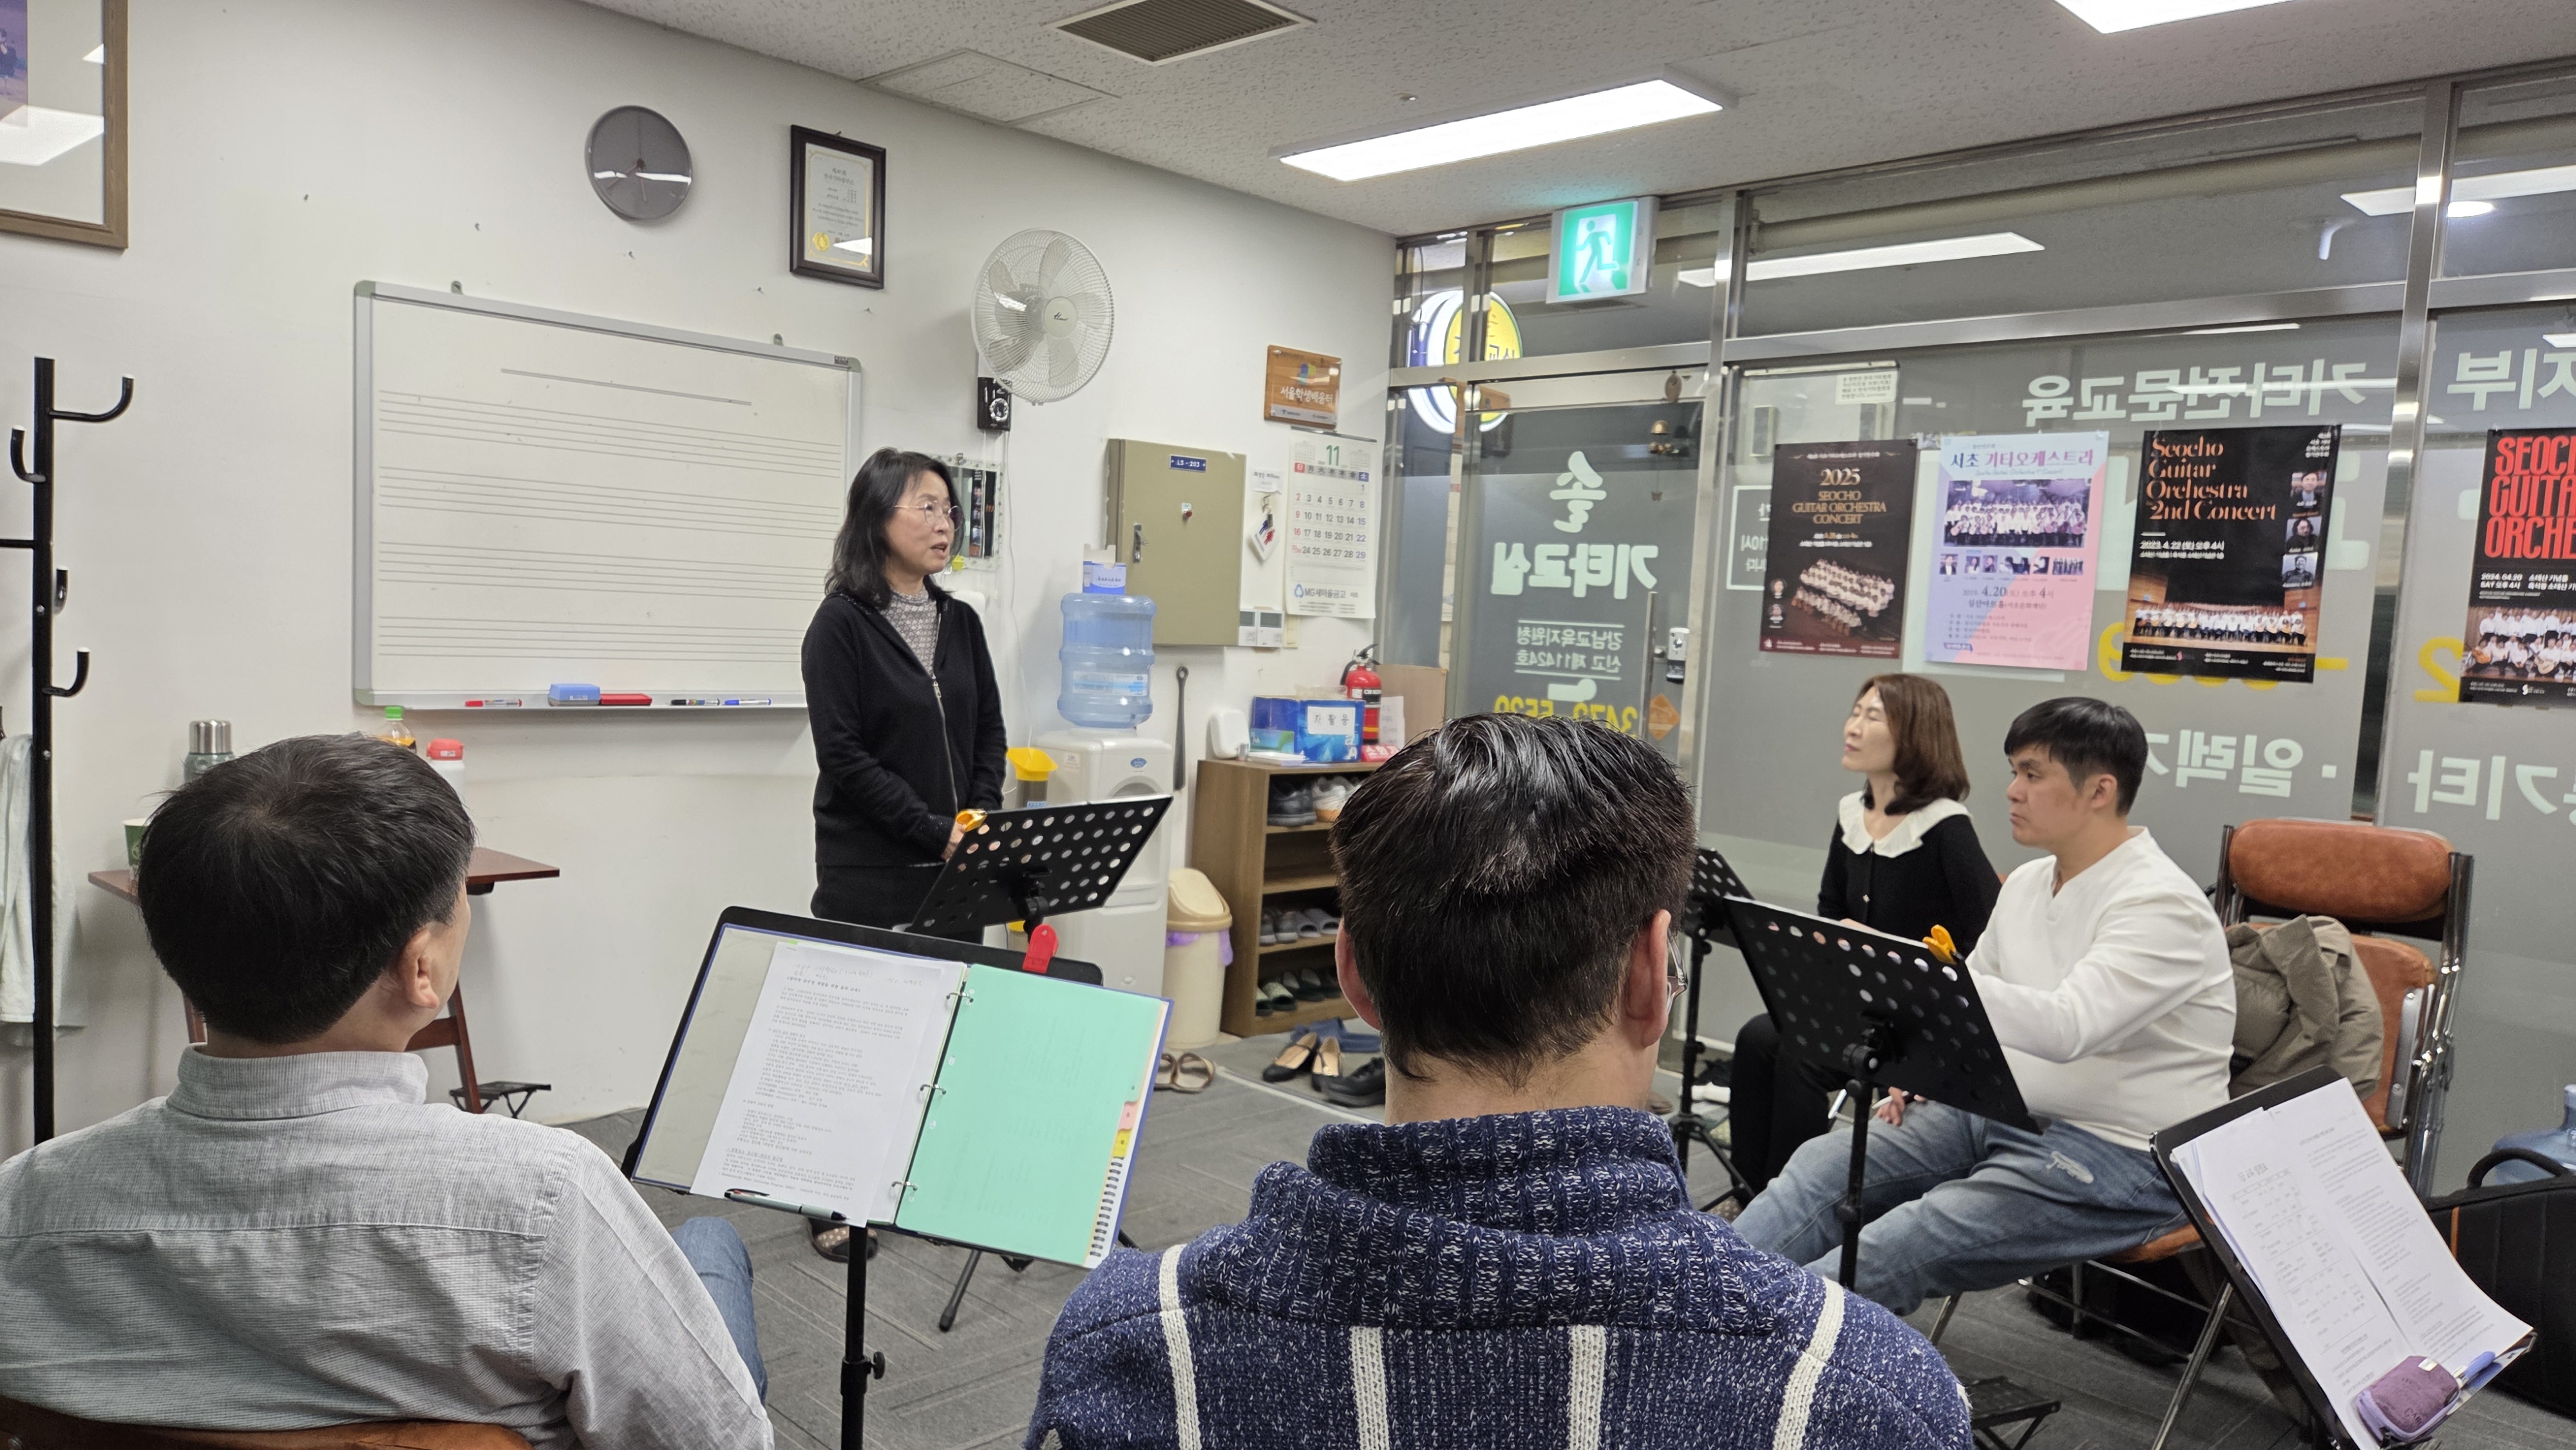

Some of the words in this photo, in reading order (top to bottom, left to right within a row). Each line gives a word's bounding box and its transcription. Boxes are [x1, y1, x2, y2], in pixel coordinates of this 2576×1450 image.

[2151, 435, 2223, 457] Seocho
[1326, 445, 1340, 466] 11
[1985, 449, 2094, 468] 기타오케스트라
[2148, 458, 2217, 478] Guitar
[1820, 467, 1861, 485] 2025
[1818, 490, 1862, 501] SEOCHO
[2146, 478, 2248, 500] Orchestra
[1296, 493, 1301, 501] 2
[1792, 502, 1828, 513] GUITAR
[1829, 501, 1887, 513] ORCHESTRA
[2148, 500, 2190, 520] 2nd
[2194, 501, 2277, 520] Concert
[1296, 510, 1300, 518] 9
[1304, 511, 1312, 520] 10
[1316, 513, 1322, 521] 11
[1326, 514, 1334, 522] 12
[1336, 515, 1343, 523] 13
[1813, 514, 1864, 524] CONCERT
[1304, 529, 1311, 537] 17
[1323, 548, 1331, 556] 26
